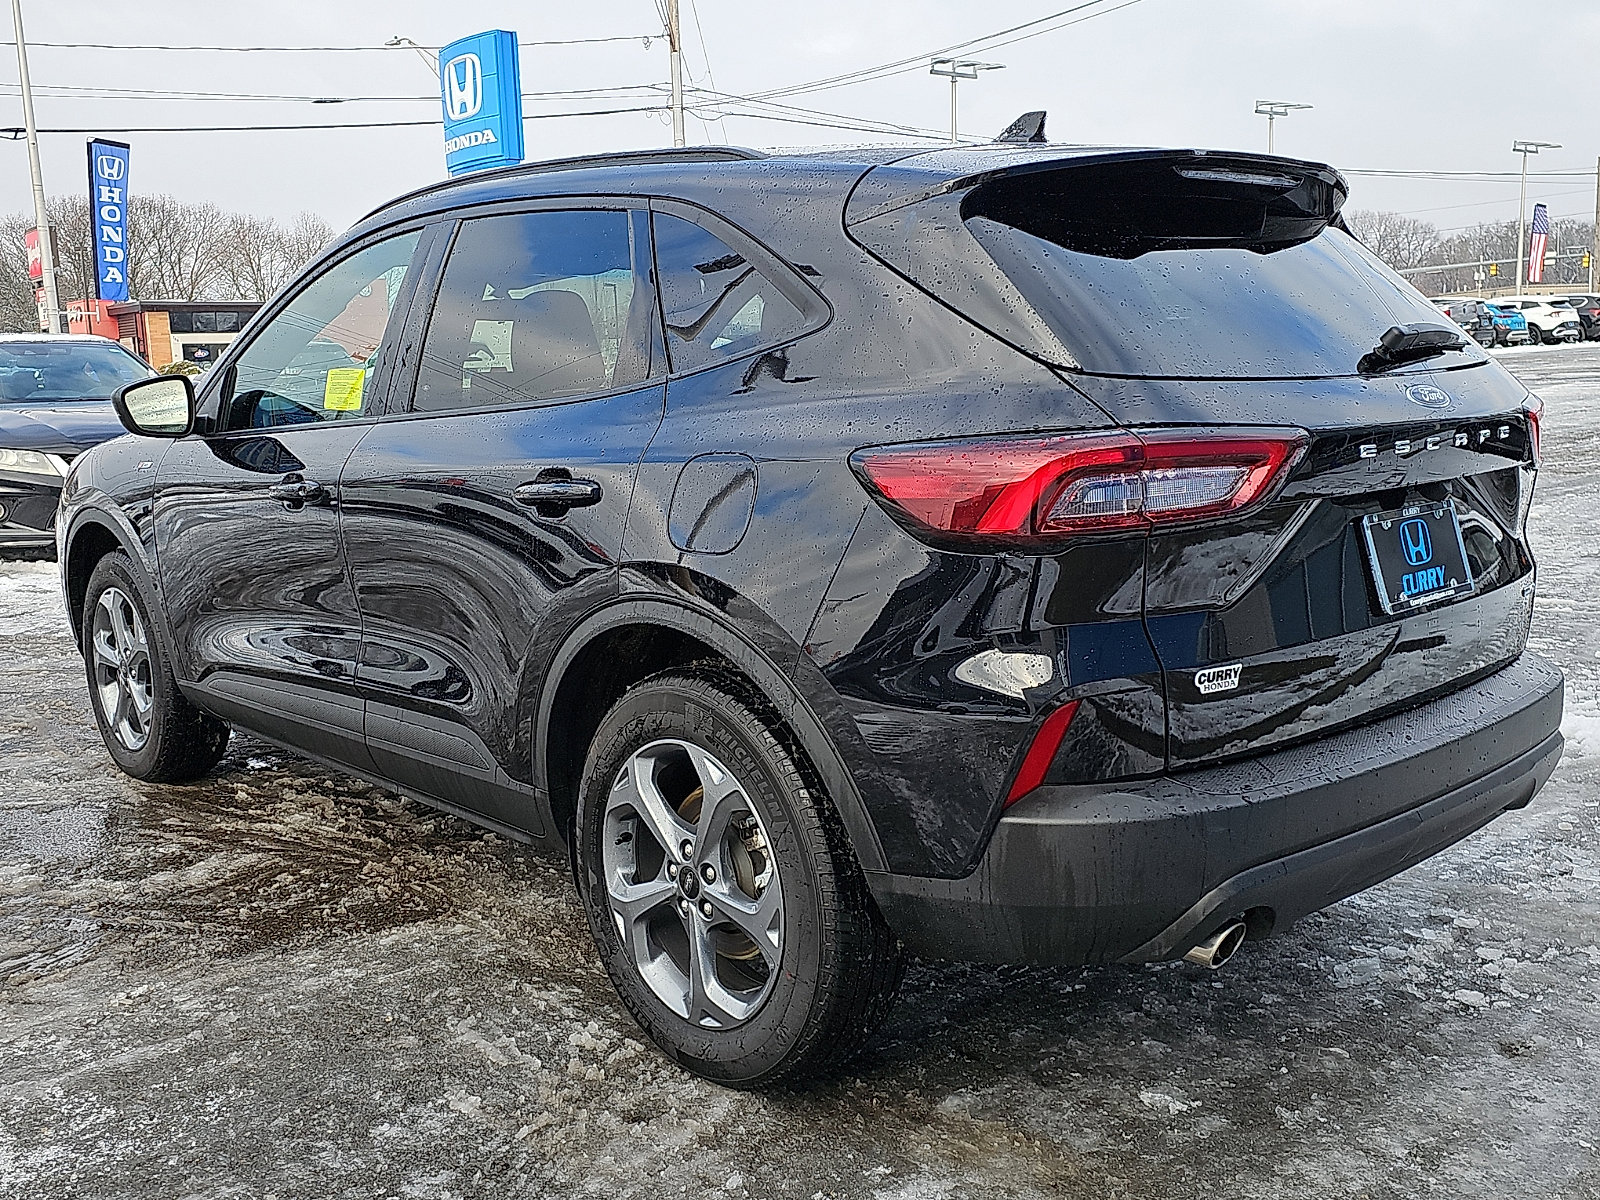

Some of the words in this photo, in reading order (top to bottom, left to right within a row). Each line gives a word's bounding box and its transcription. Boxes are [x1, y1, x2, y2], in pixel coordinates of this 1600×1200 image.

[444, 129, 498, 154] HONDA
[98, 185, 123, 283] HONDA
[1358, 425, 1511, 459] ESCAPE
[1402, 506, 1421, 517] CURRY
[1401, 564, 1446, 596] CURRY
[1197, 666, 1241, 685] CURRY
[1203, 679, 1236, 692] HONDA
[714, 727, 783, 818] MICHELIN
